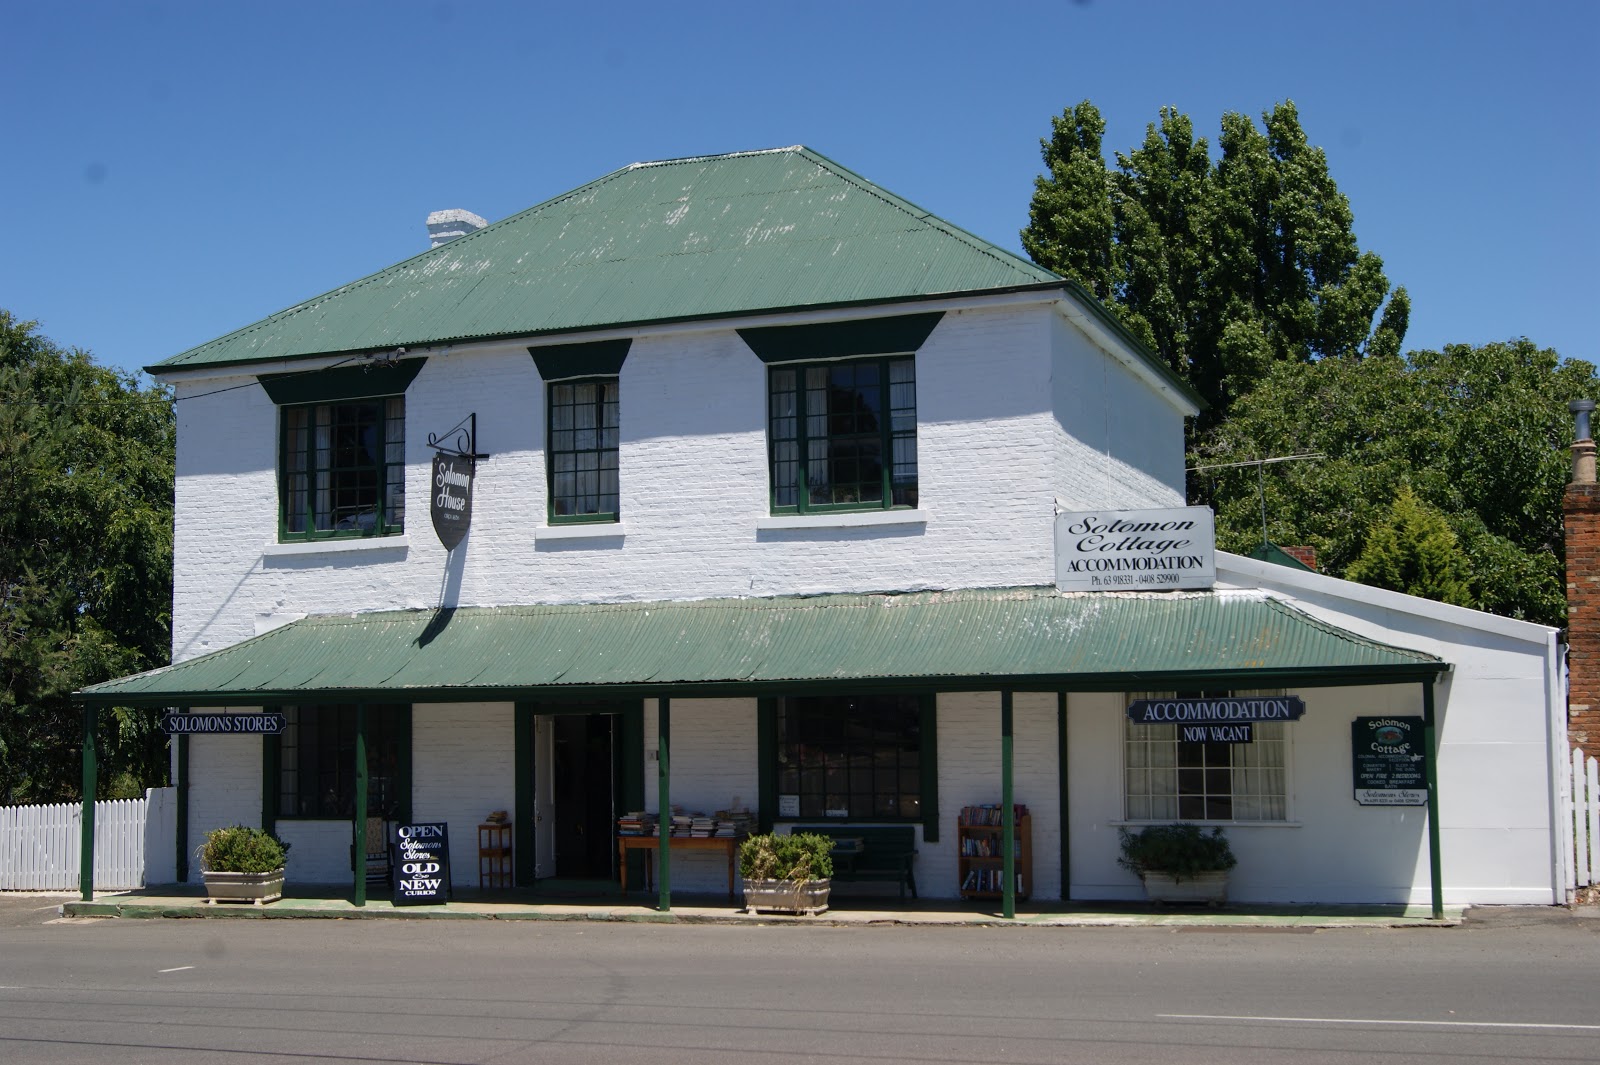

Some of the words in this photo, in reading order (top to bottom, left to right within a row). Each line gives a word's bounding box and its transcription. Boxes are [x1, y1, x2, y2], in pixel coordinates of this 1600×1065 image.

[436, 462, 469, 495] Solomon
[436, 486, 466, 512] House
[1068, 516, 1198, 535] Solomon
[1076, 534, 1193, 555] Cottage
[1067, 555, 1204, 573] ACCOMMODATION
[1091, 575, 1102, 586] Ph.
[1103, 575, 1112, 585] 63
[1112, 574, 1134, 585] 918331
[1138, 574, 1155, 585] 0408
[1156, 573, 1180, 584] 529900
[1143, 700, 1290, 721] ACCOMMODATION
[169, 716, 232, 732] SOLOMONS
[233, 715, 278, 731] STORES
[1368, 718, 1411, 731] Solomon
[1183, 727, 1208, 742] NOW
[1210, 726, 1250, 742] VACANT
[1370, 741, 1411, 755] Cottage
[398, 825, 443, 838] OPEN
[400, 838, 442, 850] Solomons
[403, 849, 431, 860] Stores
[402, 862, 441, 874] OLD
[399, 878, 443, 891] NEW
[405, 889, 437, 897] CURIOS
